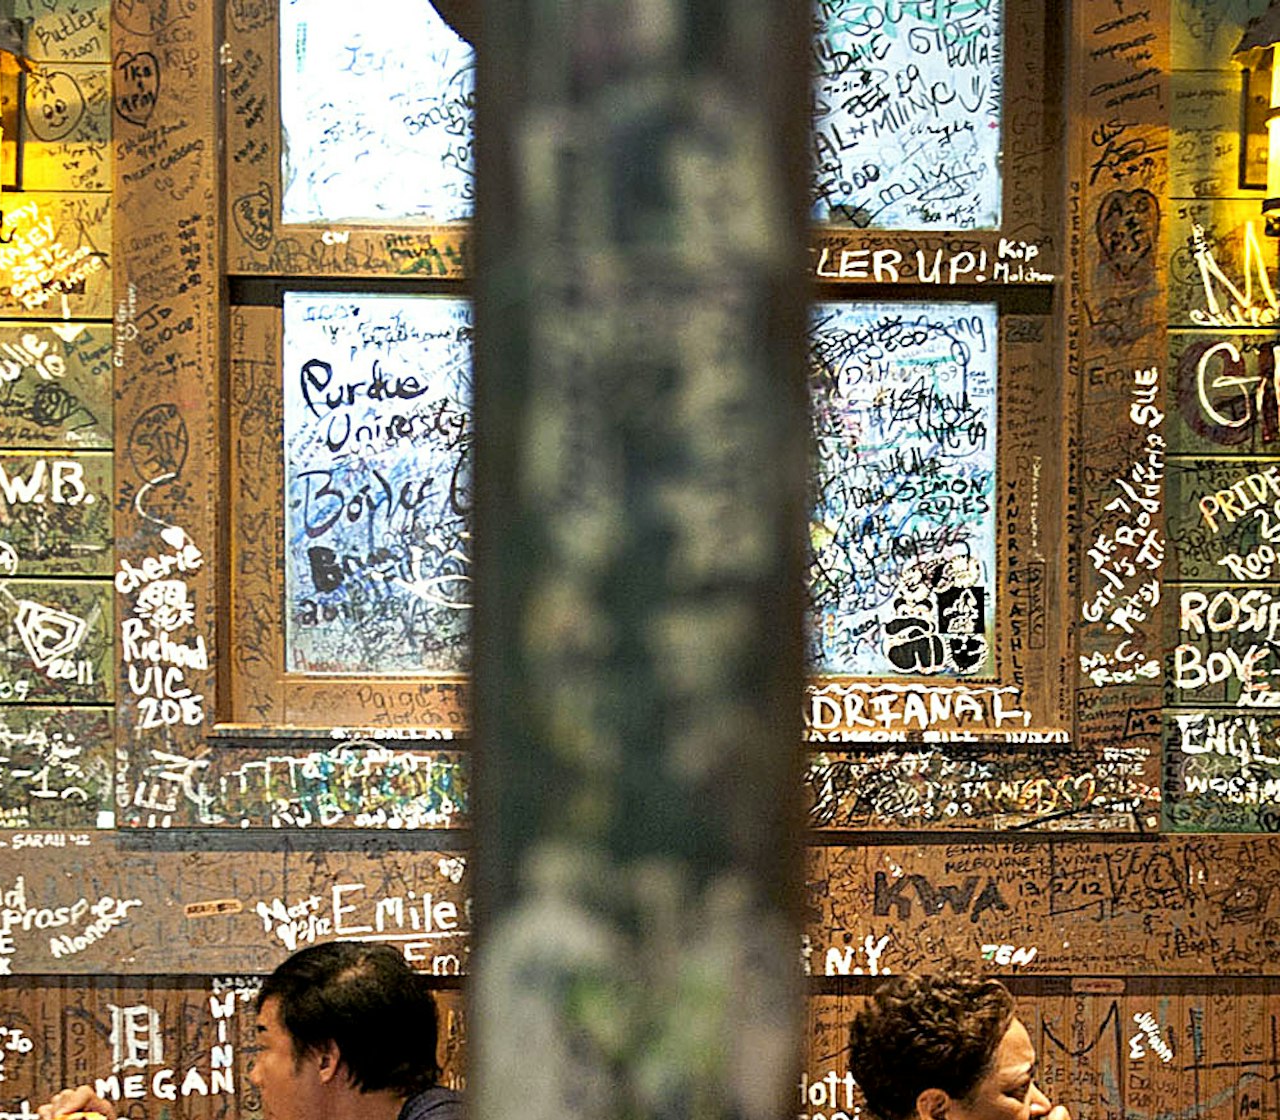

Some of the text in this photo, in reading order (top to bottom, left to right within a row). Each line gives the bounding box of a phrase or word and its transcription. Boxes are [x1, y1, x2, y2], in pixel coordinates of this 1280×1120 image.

[35, 8, 98, 58] Butler
[918, 249, 988, 284] UP!
[298, 357, 429, 419] Purdue
[94, 1069, 236, 1102] MEGAN
